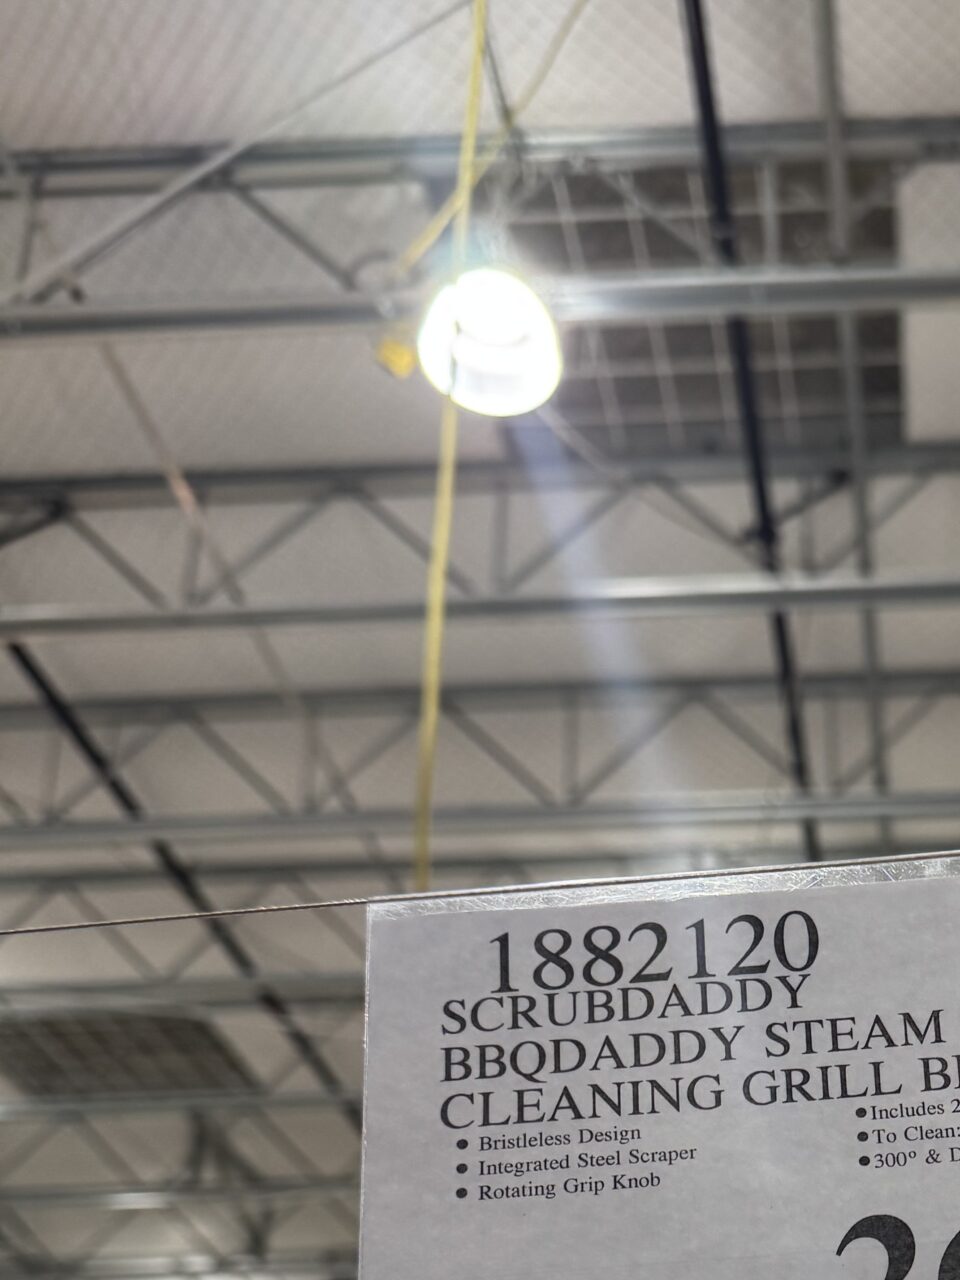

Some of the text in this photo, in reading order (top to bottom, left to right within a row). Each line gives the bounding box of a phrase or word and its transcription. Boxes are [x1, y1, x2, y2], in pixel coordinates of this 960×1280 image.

[489, 909, 820, 994] 1882120
[440, 973, 812, 1036] SCRUBDADDY
[439, 1008, 947, 1084] BBQDADDY STEAM
[439, 1073, 725, 1130] CLEANING
[742, 1060, 903, 1106] GRILL
[869, 1100, 945, 1121] Includes
[478, 1127, 643, 1152] Bristleless Design
[871, 1128, 898, 1145] To
[478, 1147, 697, 1176] Integrated Steel Scraper
[924, 1148, 943, 1165] &
[478, 1171, 661, 1201] Rotating Grip Knob
